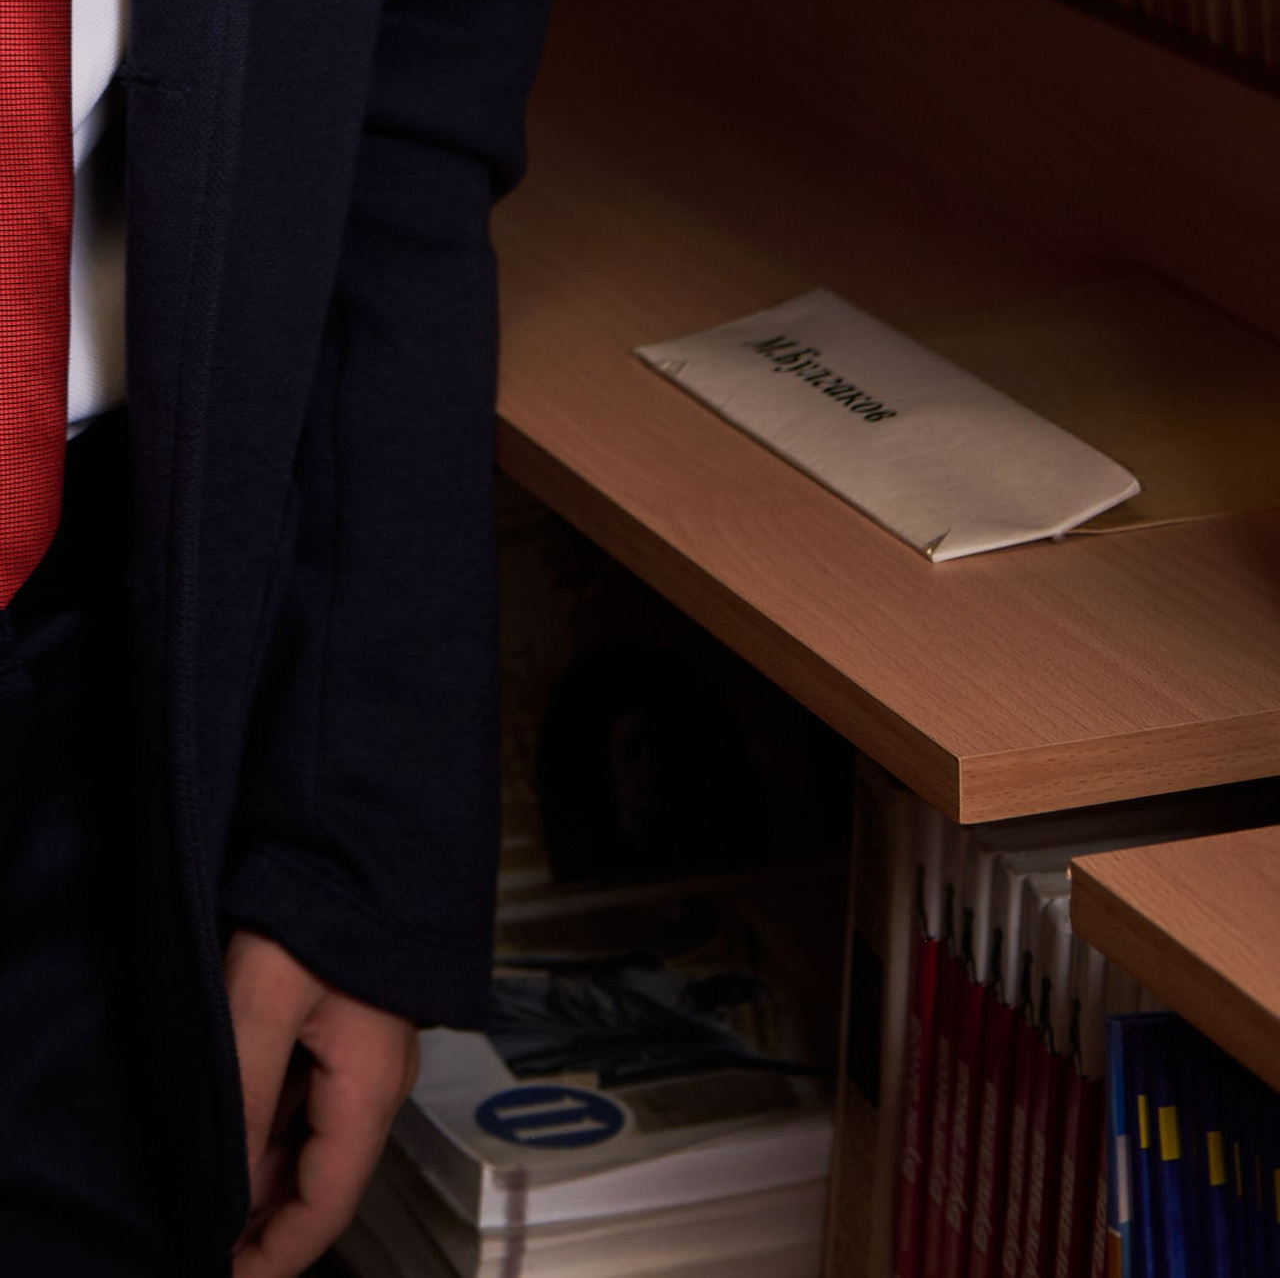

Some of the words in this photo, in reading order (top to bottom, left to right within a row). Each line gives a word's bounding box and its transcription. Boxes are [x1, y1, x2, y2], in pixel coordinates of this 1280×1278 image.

[945, 1059, 970, 1233] Булгаков
[971, 1078, 998, 1255] Булгаков
[1002, 1102, 1027, 1278] Булгаков
[1023, 1129, 1047, 1278] улгаков
